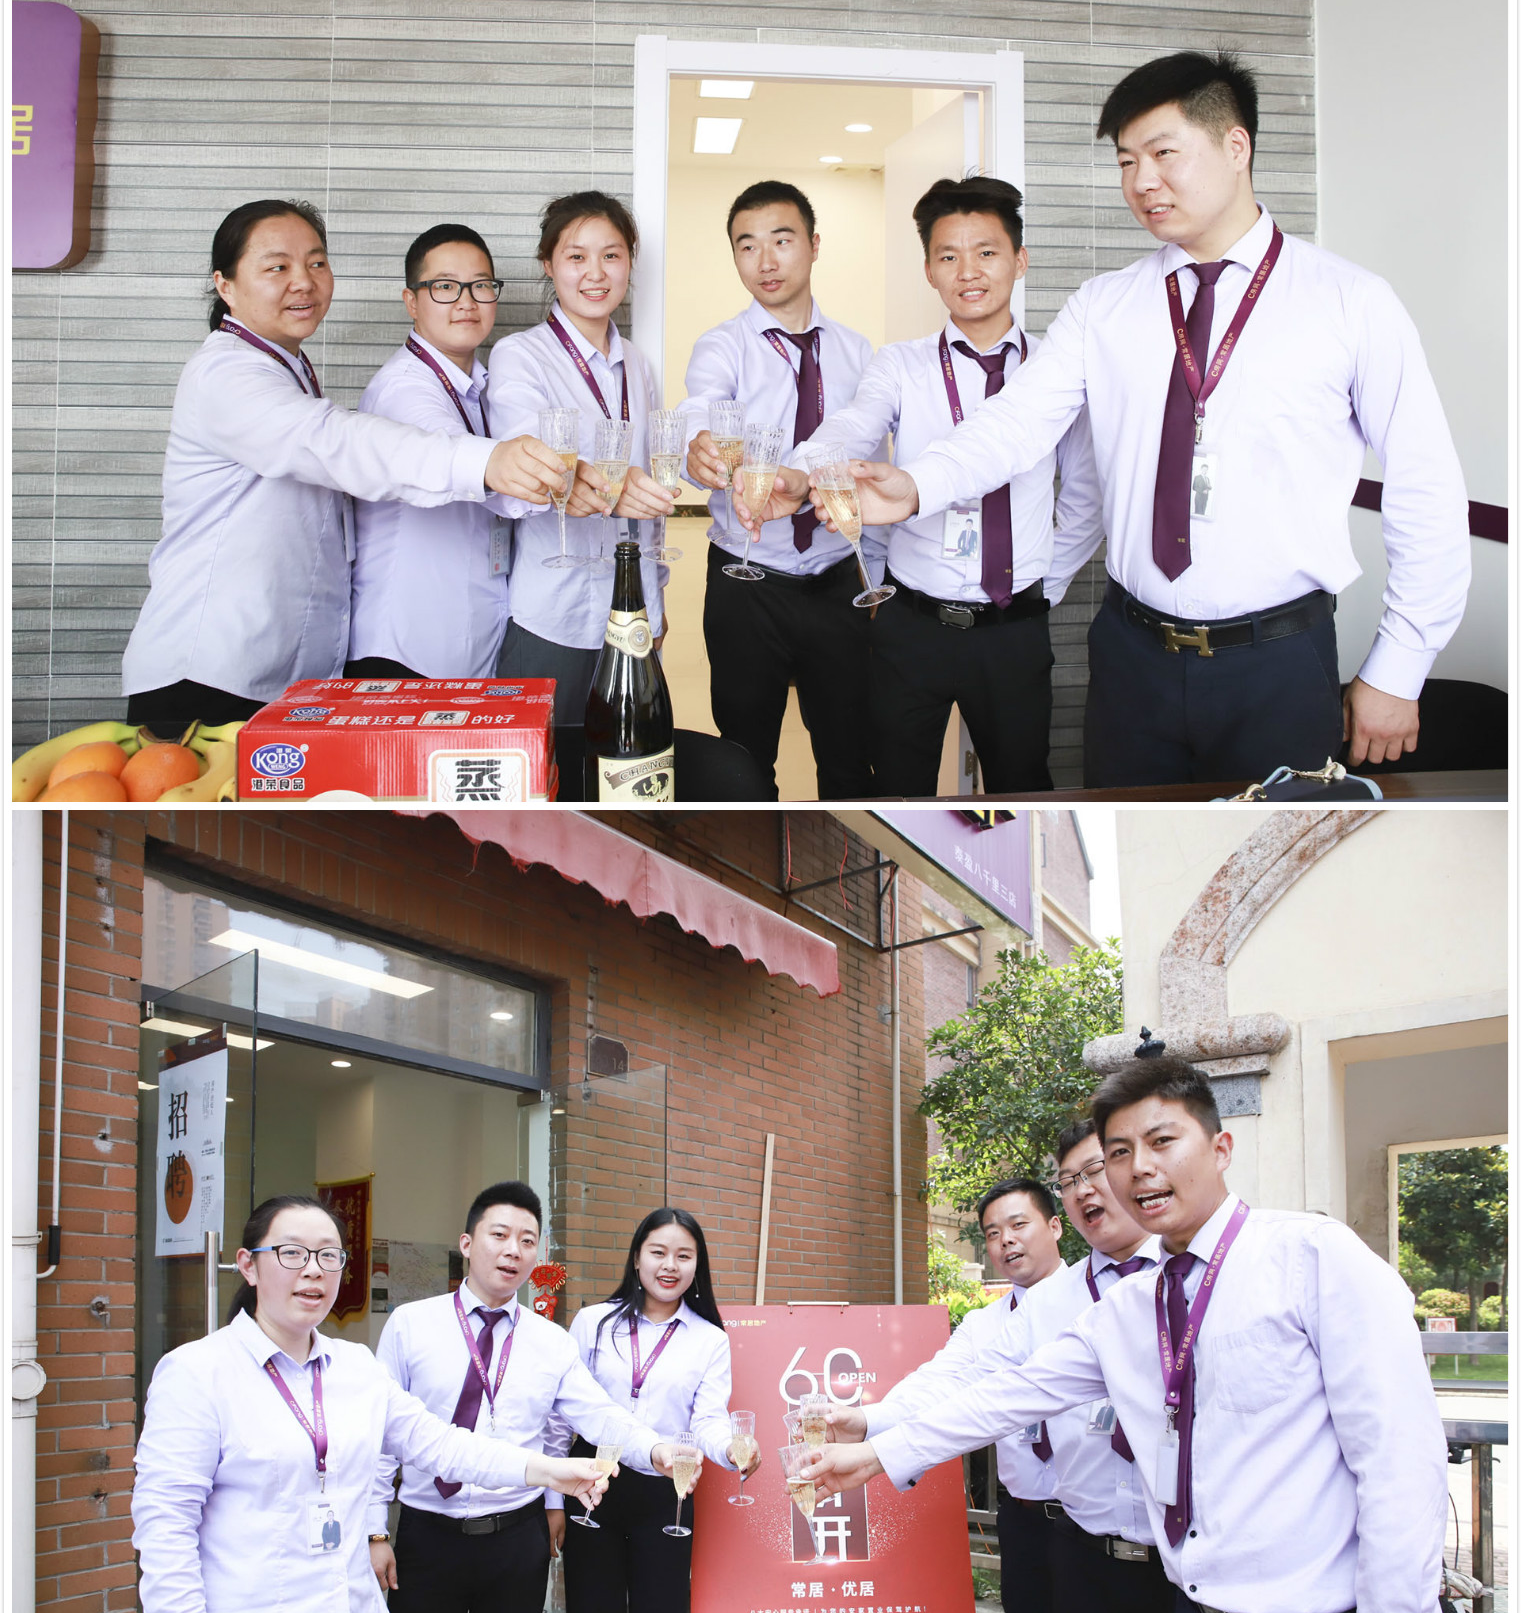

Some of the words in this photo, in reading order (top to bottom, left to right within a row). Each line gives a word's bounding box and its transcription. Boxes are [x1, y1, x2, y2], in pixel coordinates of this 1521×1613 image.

[325, 715, 417, 726] 蛋糕还是
[470, 714, 516, 724] 的好
[252, 778, 304, 791] 港荣食品
[454, 759, 503, 802] 蒸
[166, 1090, 188, 1199] 招聘
[838, 1371, 876, 1384] OPEN
